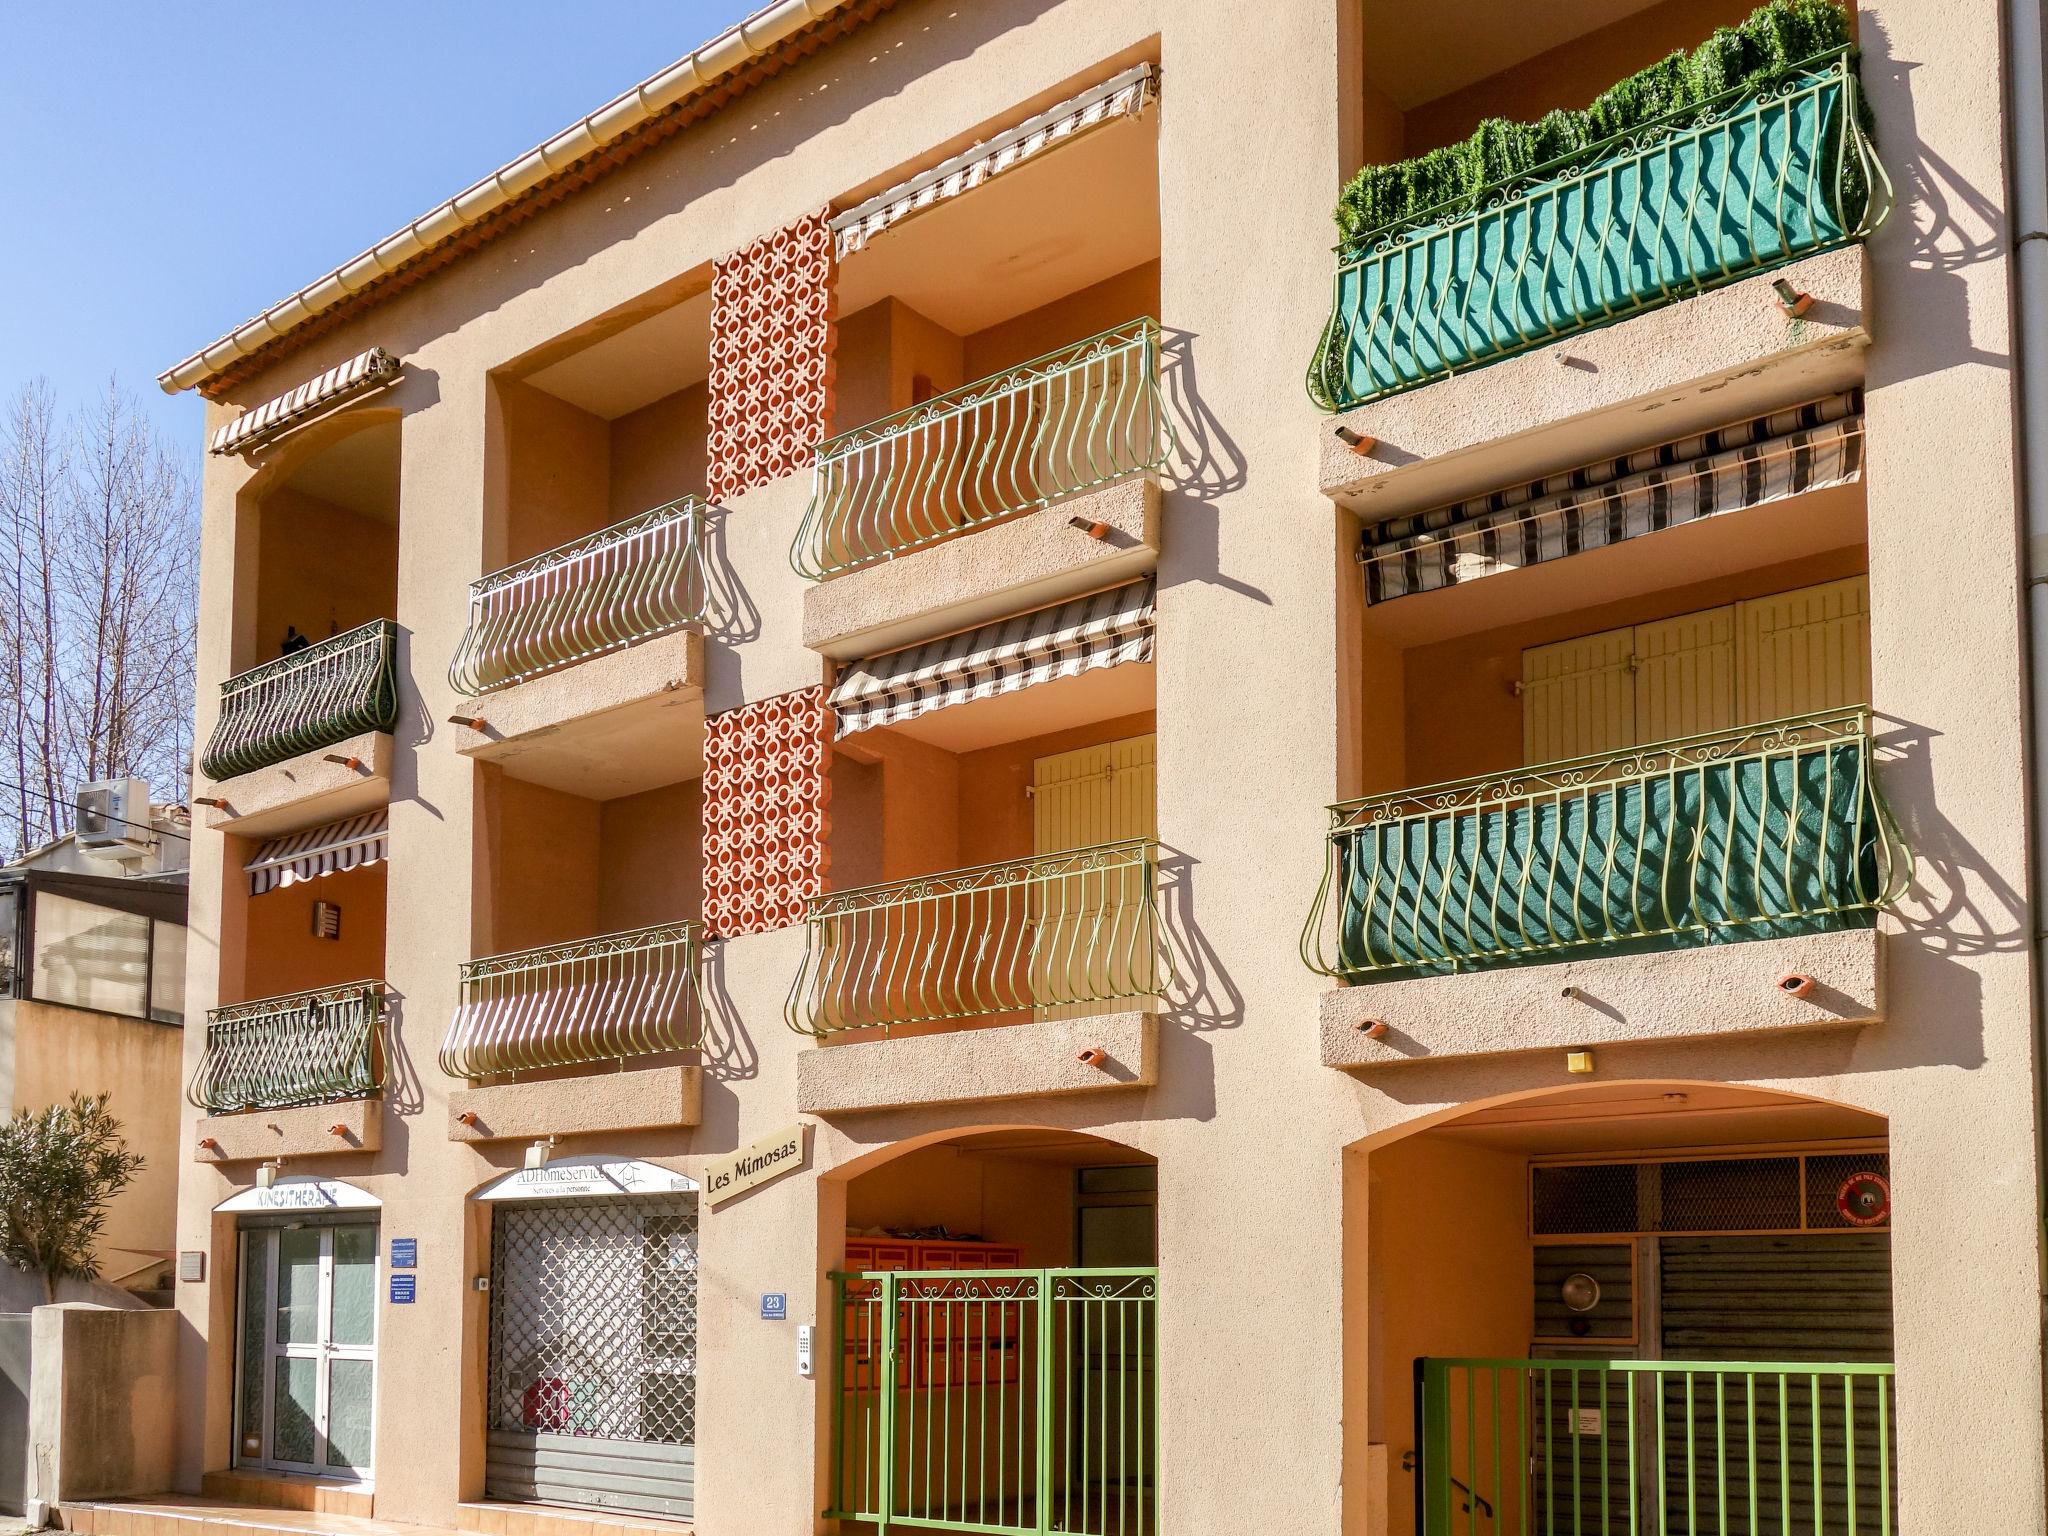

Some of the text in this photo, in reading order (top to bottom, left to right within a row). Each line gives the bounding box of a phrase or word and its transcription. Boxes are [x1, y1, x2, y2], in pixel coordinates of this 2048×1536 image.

[707, 1140, 797, 1194] Les Mimosas
[566, 1185, 591, 1195] personne
[766, 1296, 780, 1309] 23
